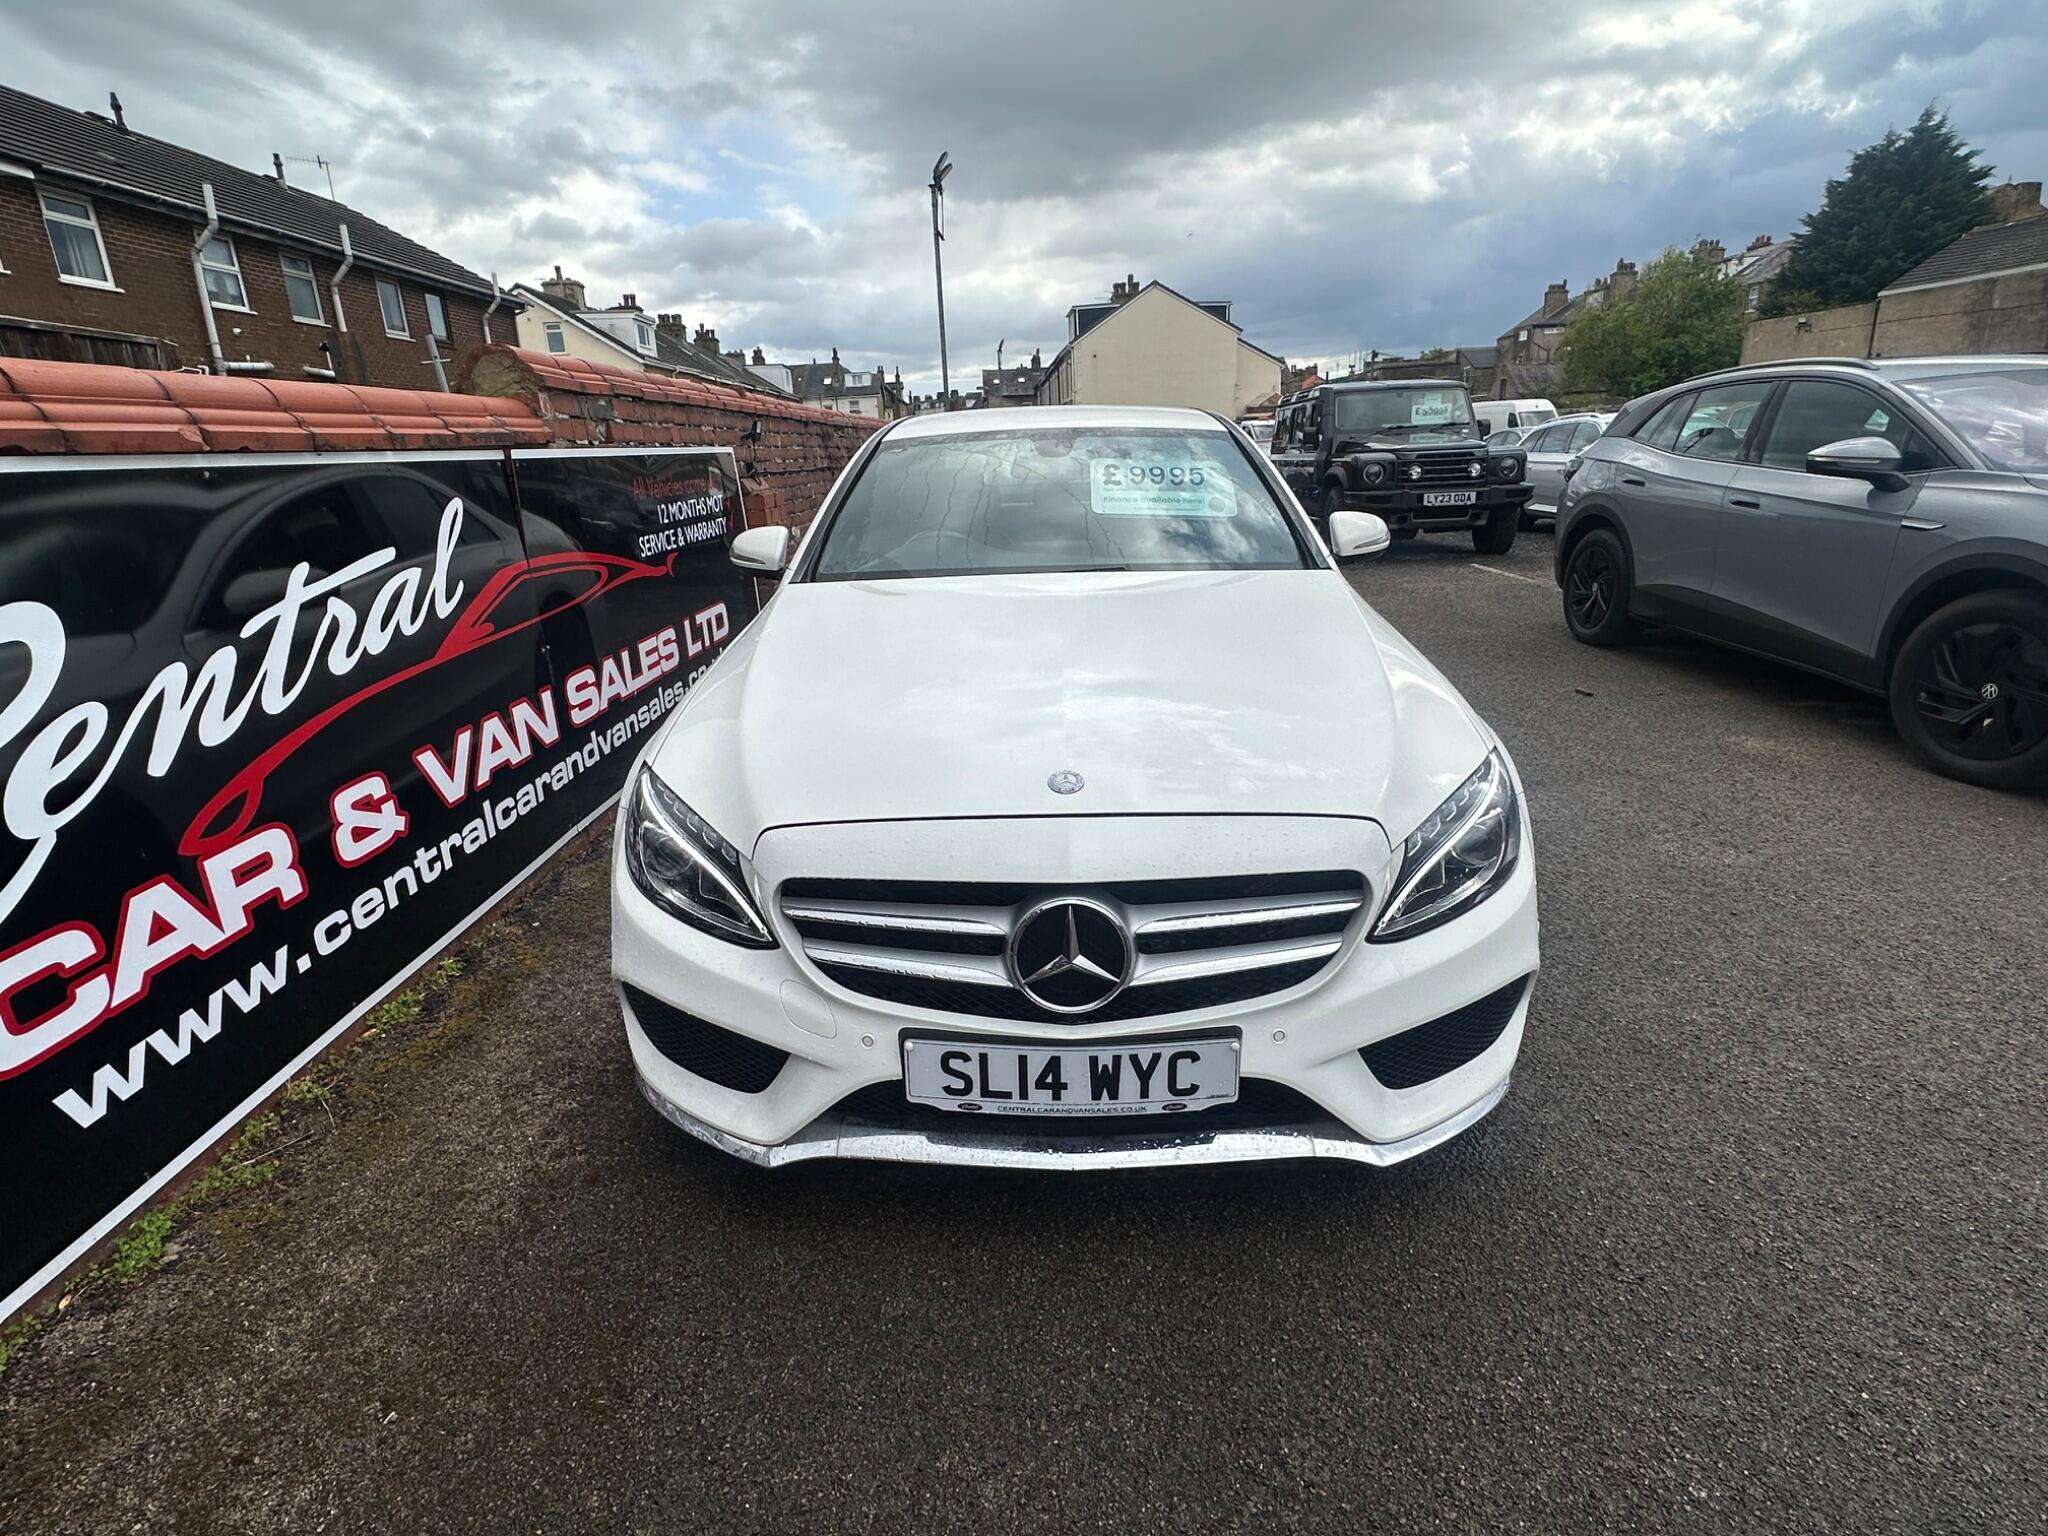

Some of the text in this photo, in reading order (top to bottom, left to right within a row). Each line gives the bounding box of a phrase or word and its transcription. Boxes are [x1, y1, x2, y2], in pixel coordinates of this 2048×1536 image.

[1102, 463, 1205, 487] £9995
[656, 494, 724, 525] 12 MONTHS MOT
[1427, 493, 1452, 504] LY23
[638, 516, 728, 558] SERVICE & WARRANTY
[0, 601, 730, 1077] CAR & VAN SALES LTD
[52, 646, 724, 1128] www.centralcarandvansales.co
[939, 1050, 1201, 1102] SL14 WYC
